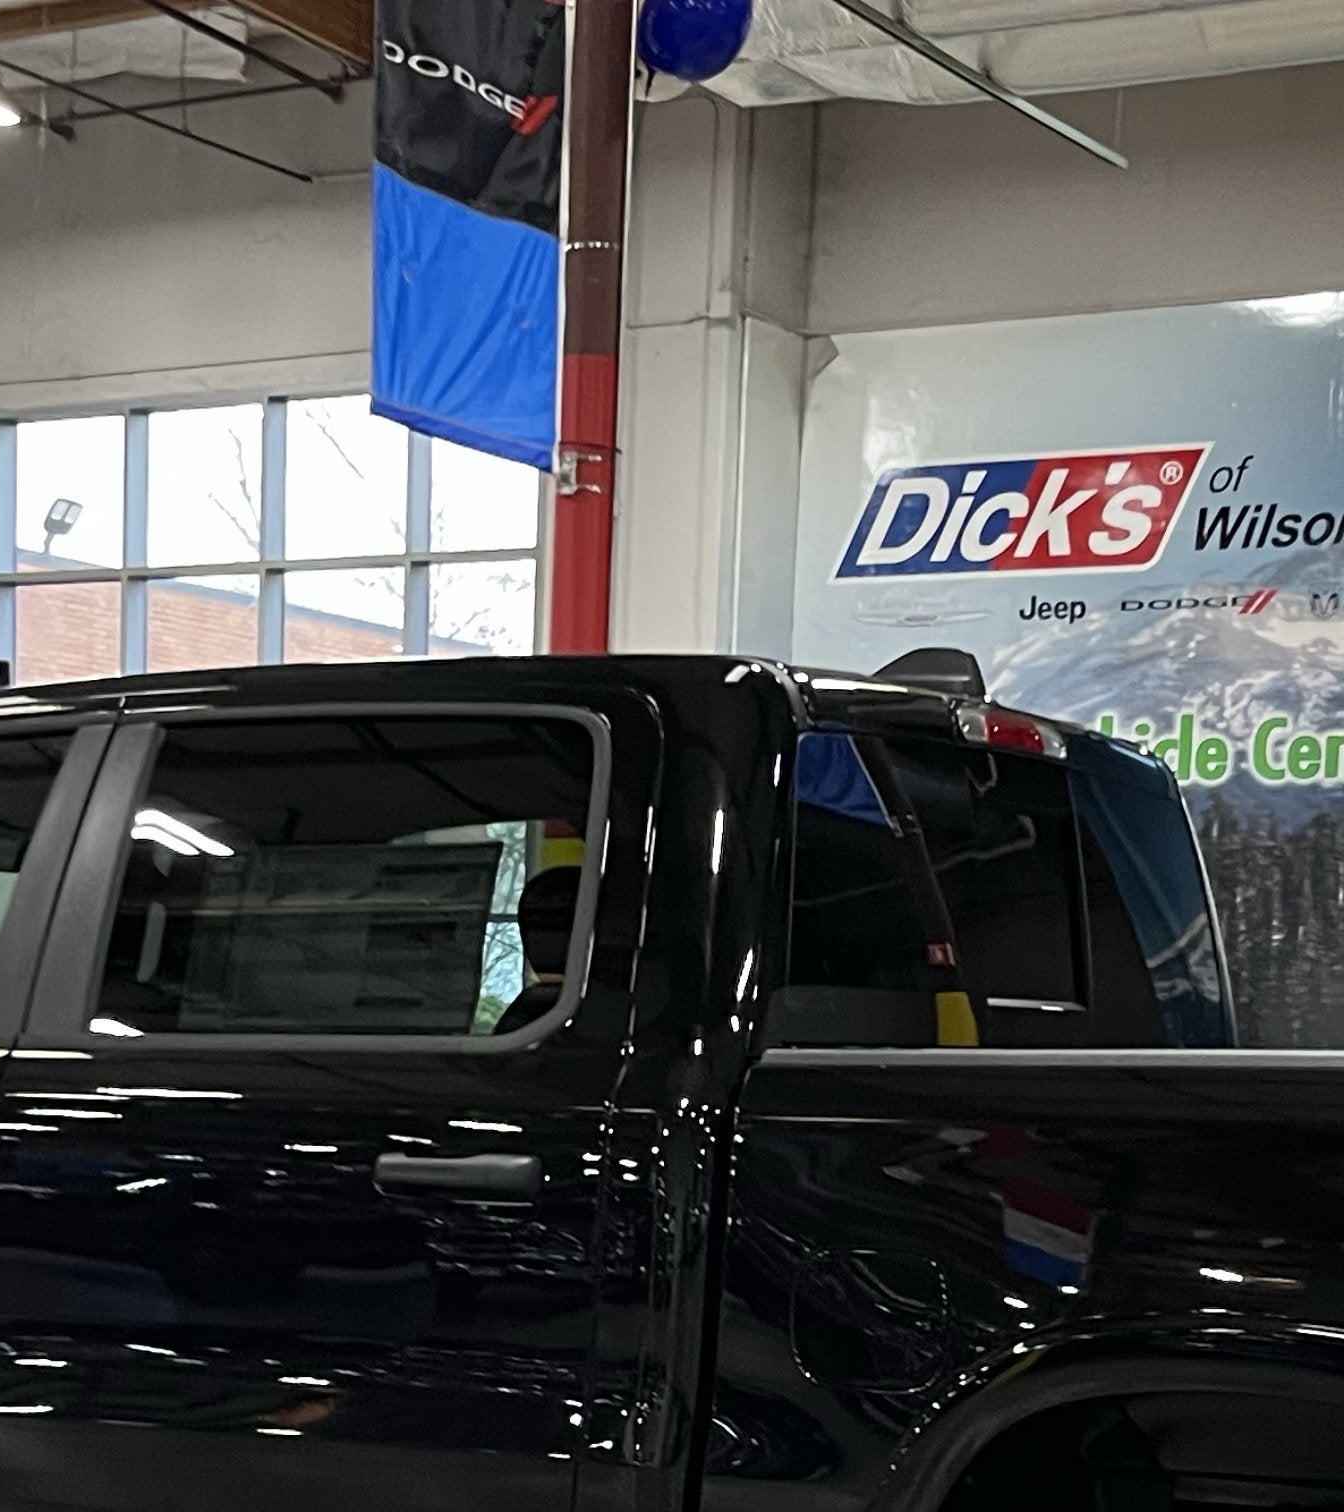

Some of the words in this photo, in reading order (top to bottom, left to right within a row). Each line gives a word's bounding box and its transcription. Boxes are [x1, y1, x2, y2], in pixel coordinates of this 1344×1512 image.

[382, 39, 527, 121] DODGE
[1207, 455, 1256, 495] of
[1018, 595, 1088, 625] Jeep
